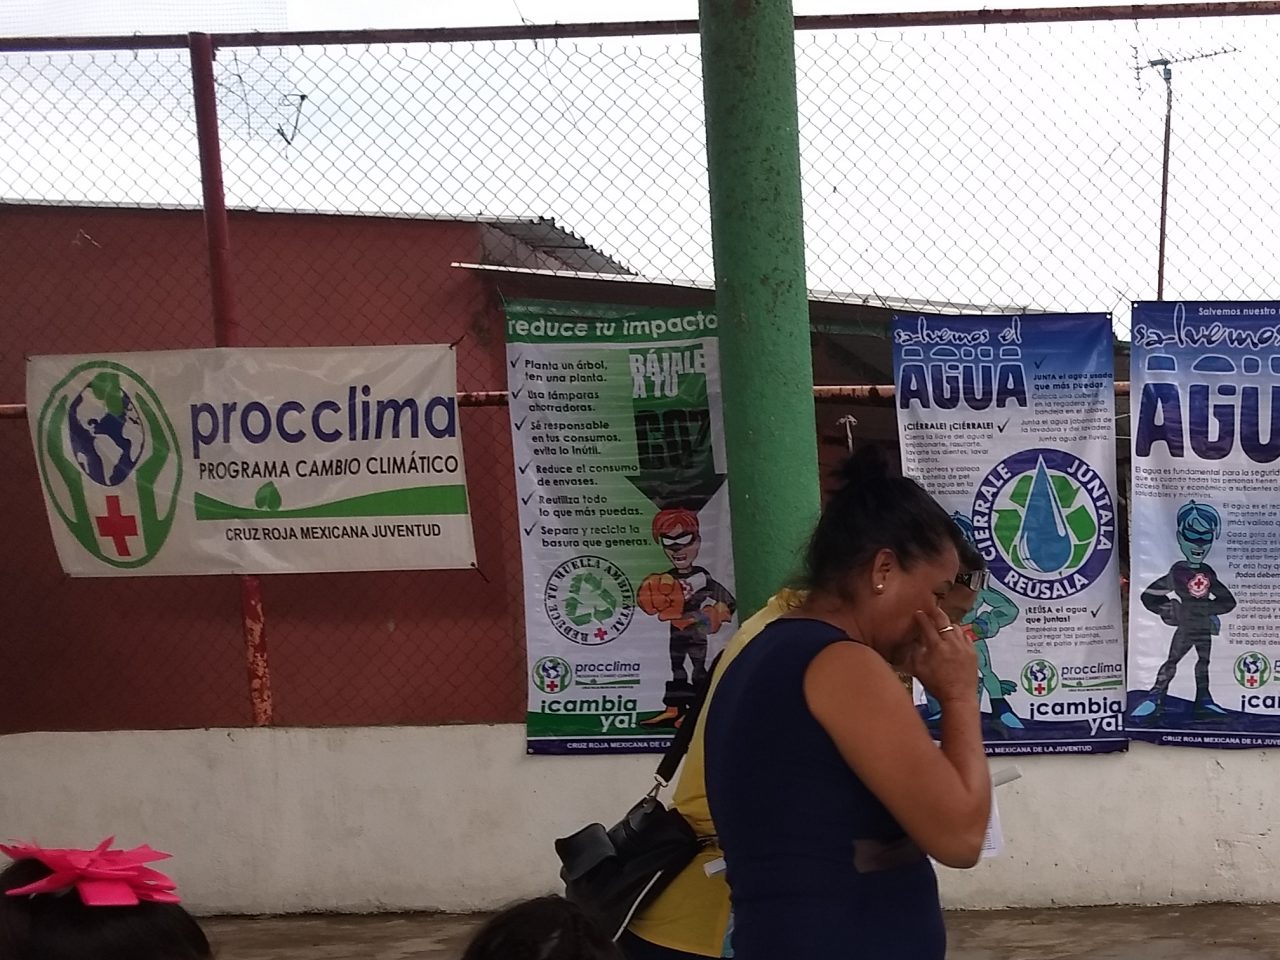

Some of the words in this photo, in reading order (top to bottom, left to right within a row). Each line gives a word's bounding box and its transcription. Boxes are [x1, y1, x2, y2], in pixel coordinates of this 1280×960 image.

[1199, 307, 1240, 315] Salvemos
[1243, 307, 1276, 315] nuestro
[508, 314, 588, 336] reduce
[596, 322, 614, 336] tu
[623, 312, 718, 337] impacto
[894, 316, 989, 344] salvemos
[999, 316, 1021, 343] el
[525, 360, 559, 370] Planta
[562, 361, 574, 369] un
[576, 360, 607, 370] árbol,
[629, 349, 706, 376] BÁJALE
[525, 373, 542, 382] ten
[546, 373, 566, 382] una
[570, 373, 607, 383] planta.
[633, 374, 647, 398] A
[651, 373, 678, 397] TU
[901, 362, 1028, 411] AGUA
[190, 386, 456, 459] procclima
[199, 461, 289, 480] PROGRAMA
[295, 459, 360, 477] CAMBIO
[366, 451, 458, 474] CLIMÁTICO
[536, 465, 572, 474] Reduce
[576, 464, 586, 473] el
[589, 465, 638, 473] consumo
[537, 477, 550, 486] de
[553, 478, 598, 486] envases.
[226, 527, 260, 541] CRUZ
[262, 526, 298, 540] ROJA
[300, 526, 369, 539] MEXICANA
[371, 524, 441, 538] JUVENTUD
[541, 526, 578, 536] Separa
[582, 527, 587, 536] y
[591, 525, 626, 535] recicla
[629, 525, 640, 534] la
[542, 538, 579, 547] basura
[583, 539, 602, 549] que
[605, 537, 651, 548] generas.
[1004, 570, 1089, 598] REÚSALA
[1025, 605, 1052, 615] ¡REÚSA
[1066, 606, 1087, 615] agua
[1026, 616, 1041, 624] que
[575, 661, 640, 675] procclima
[1062, 662, 1122, 677] procclima
[541, 695, 637, 714] ¡cambia
[1030, 697, 1122, 720] ¡cambia
[600, 712, 637, 732] ya!
[1088, 715, 1123, 735] ya!
